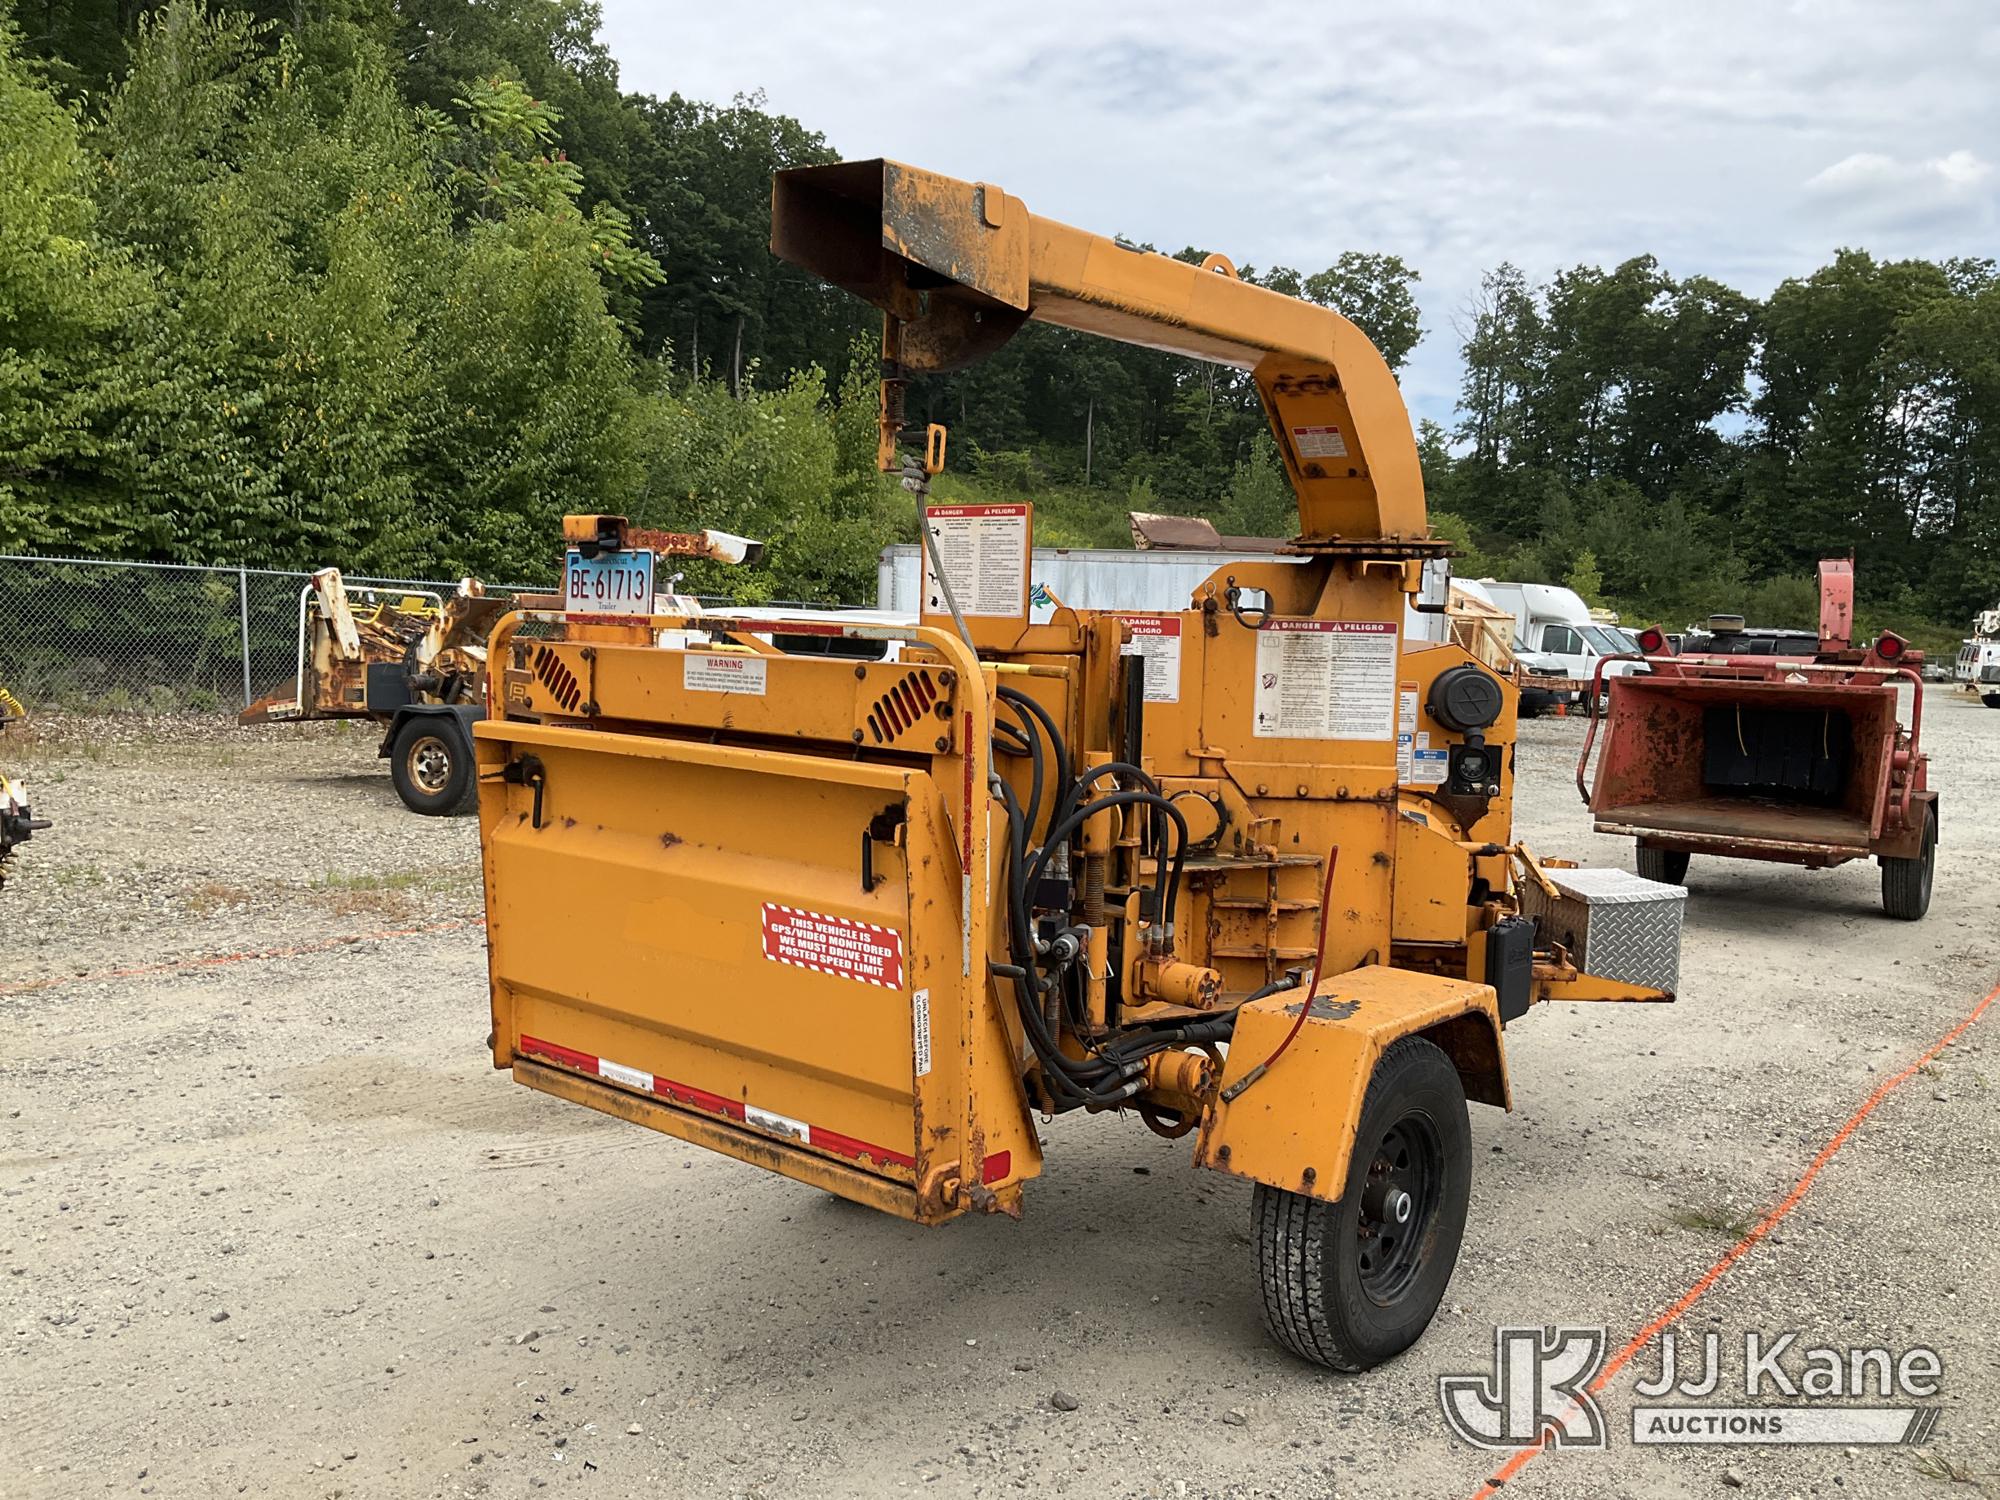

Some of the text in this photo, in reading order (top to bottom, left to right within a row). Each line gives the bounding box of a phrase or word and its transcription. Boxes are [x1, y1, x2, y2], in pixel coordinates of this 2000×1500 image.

[598, 602, 616, 610] Trailer
[1282, 622, 1384, 631] DANGER PELIGRO
[707, 658, 744, 669] WARNING
[771, 923, 892, 958] GPS/VIDEO MONITORED
[789, 917, 872, 943] THIS VEHICLE IS
[779, 934, 883, 966] WE MUST DRIVE THE
[779, 945, 884, 977] POSTED SPEED LIMIT
